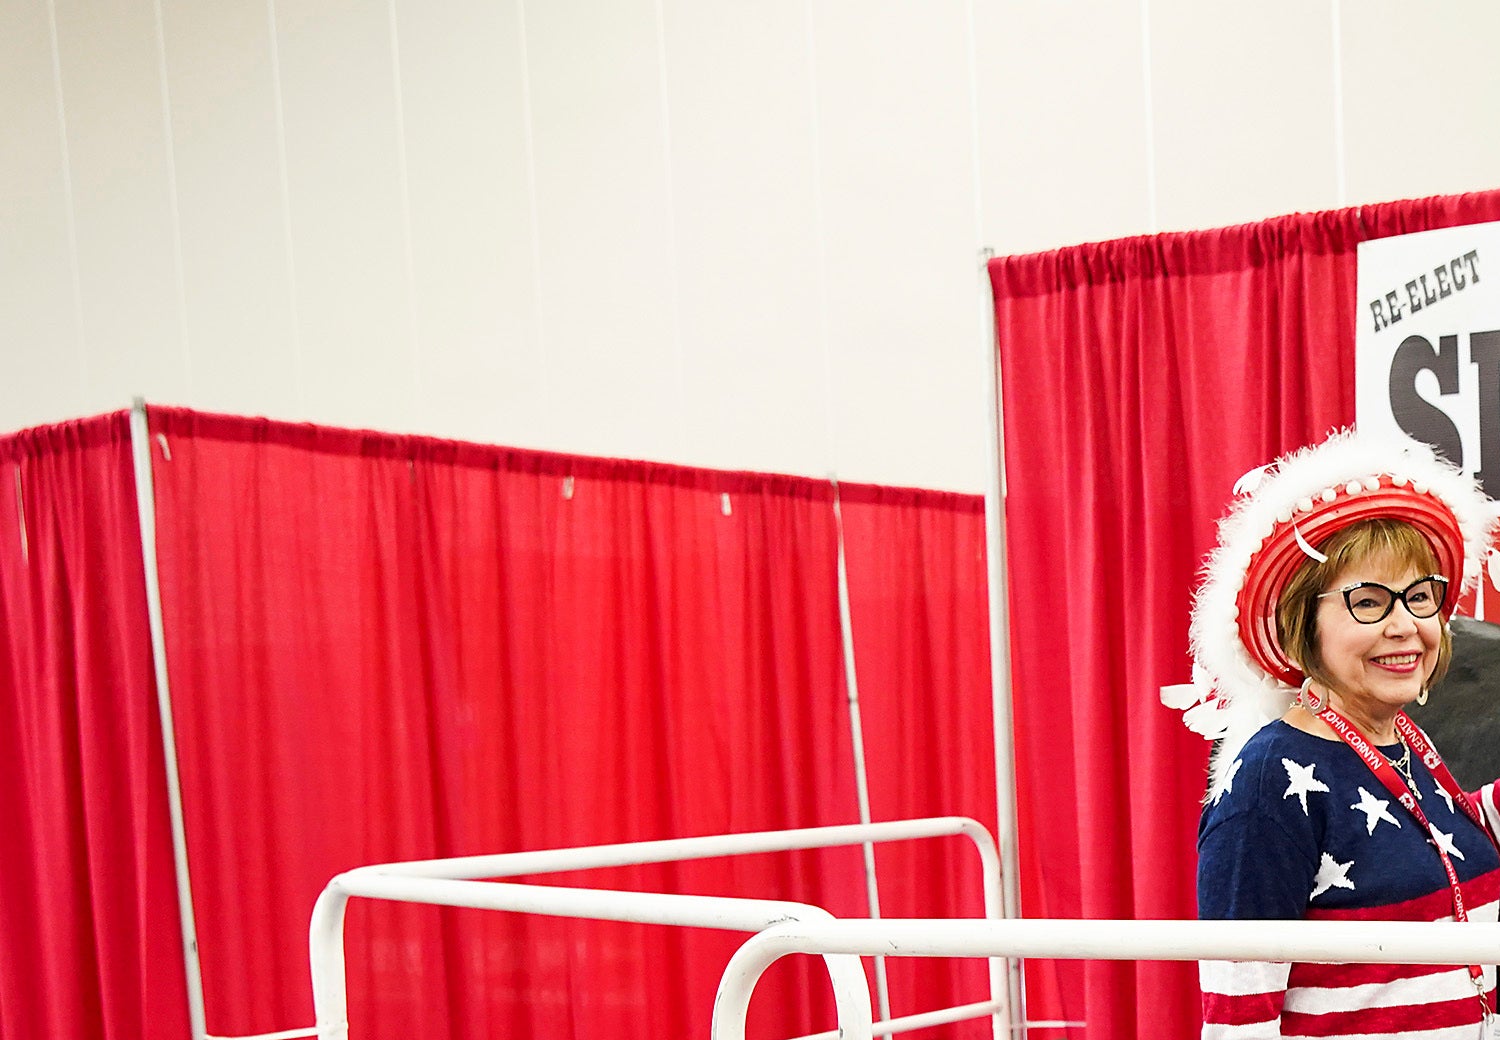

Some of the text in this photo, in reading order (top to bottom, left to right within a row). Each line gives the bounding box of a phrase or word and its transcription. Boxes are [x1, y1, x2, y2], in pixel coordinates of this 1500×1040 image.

[1370, 249, 1481, 333] RE-ELECT
[1322, 710, 1383, 770] JOHN CORNYN
